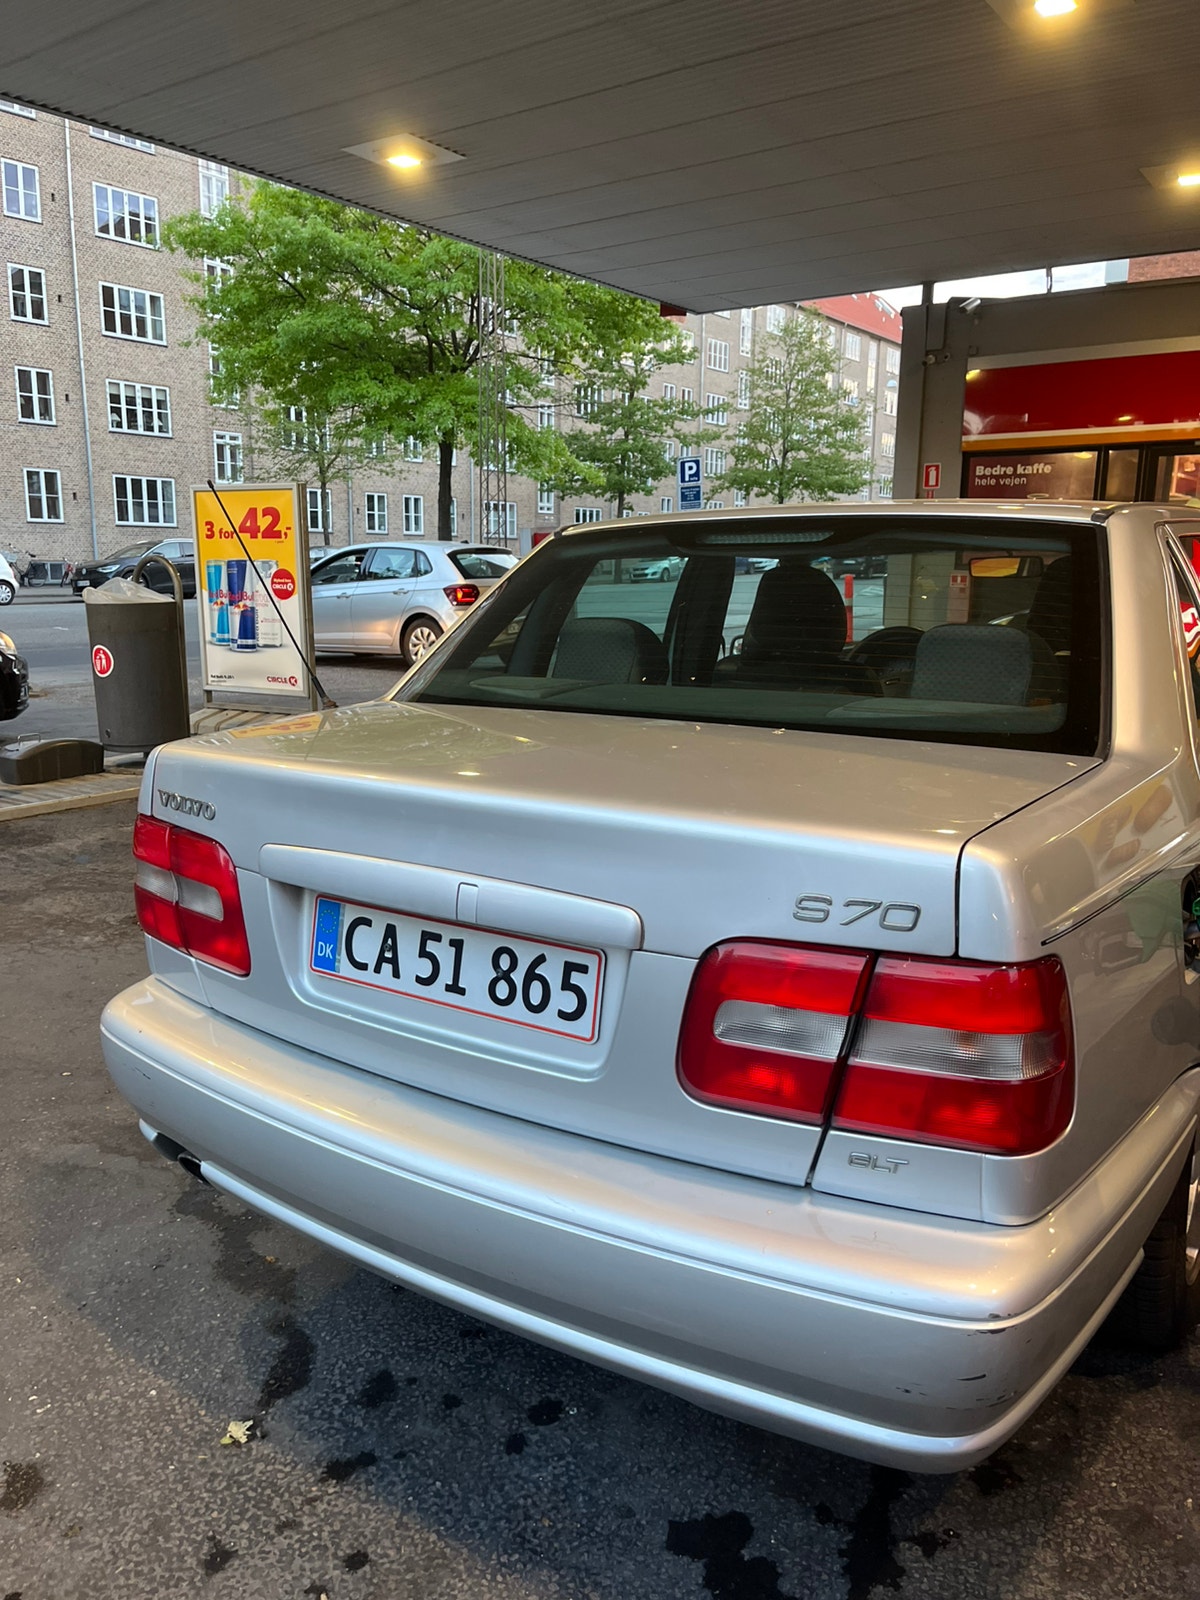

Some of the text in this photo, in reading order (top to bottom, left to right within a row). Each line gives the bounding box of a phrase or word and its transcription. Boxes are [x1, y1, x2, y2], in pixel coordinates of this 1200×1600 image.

[684, 462, 697, 481] P
[975, 463, 1052, 476] Bedre kaffe
[975, 476, 1027, 486] hele vejen
[204, 520, 215, 539] 3
[218, 527, 235, 539] for
[266, 675, 288, 684] CIRCLE
[157, 789, 217, 821] VOLVO
[317, 940, 334, 960] DK
[344, 916, 590, 1023] CA 51 865
